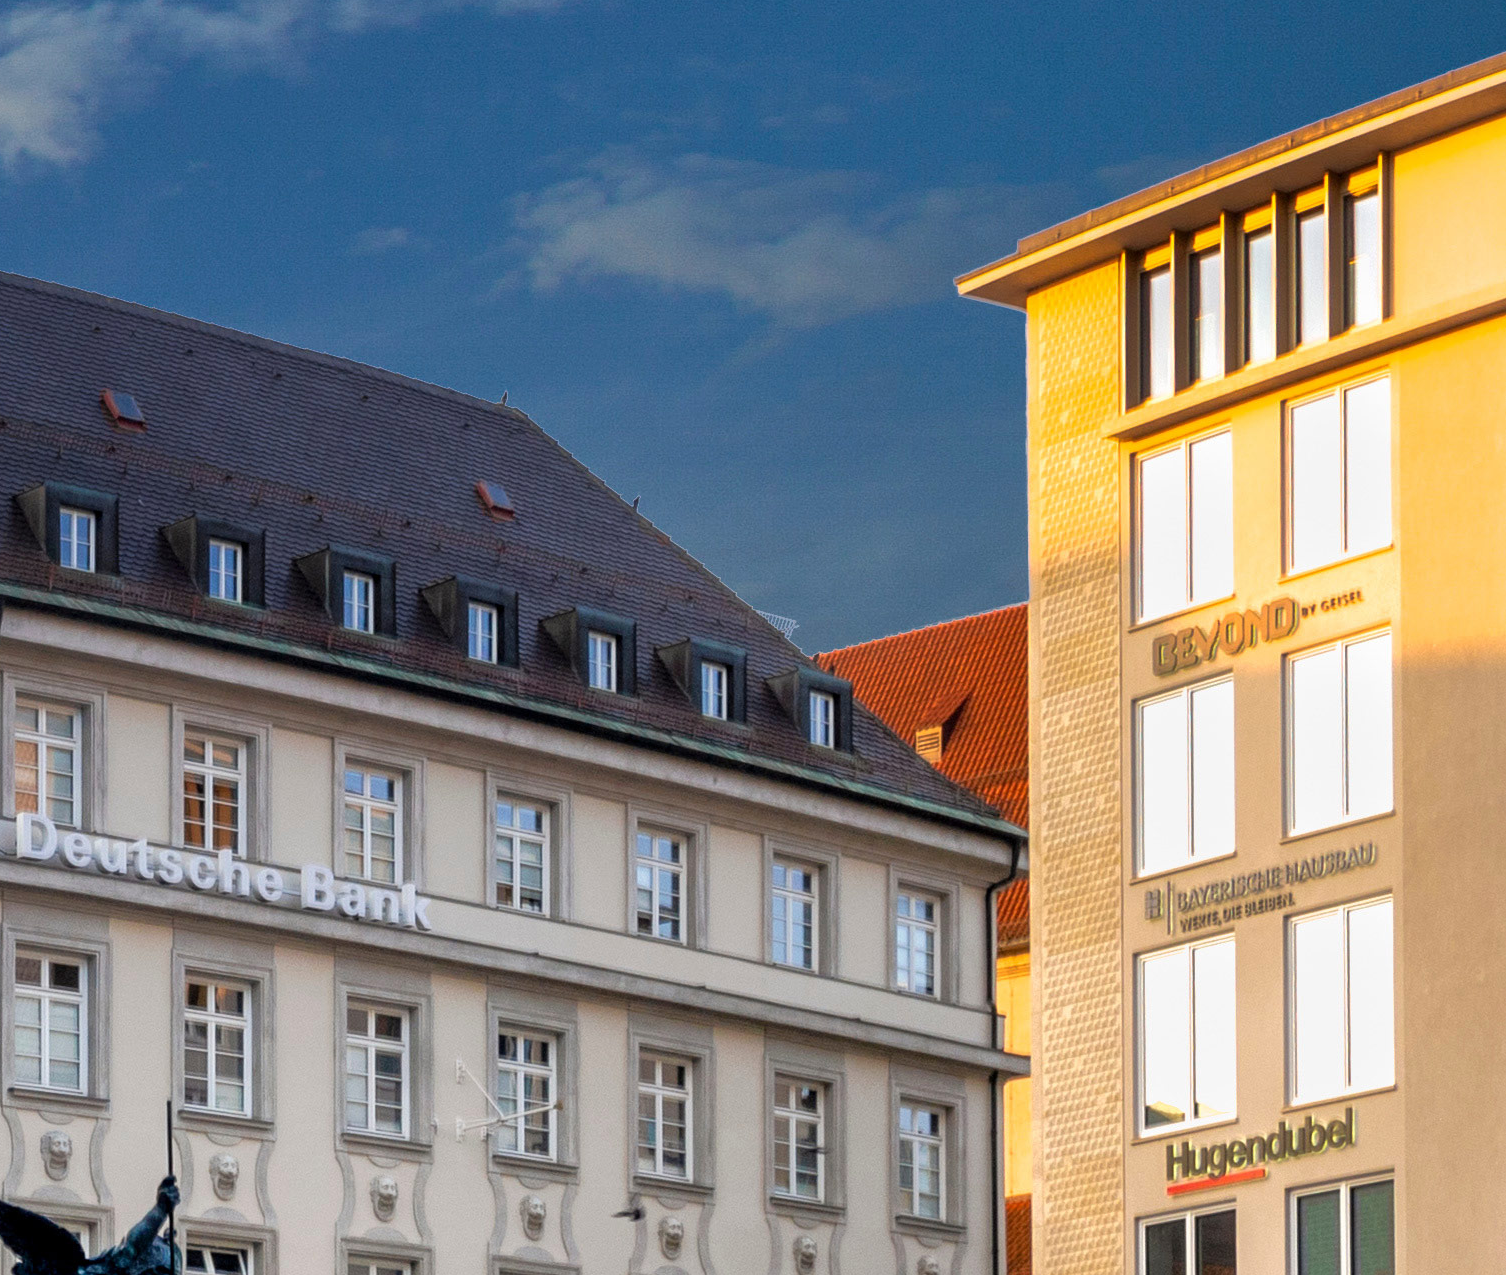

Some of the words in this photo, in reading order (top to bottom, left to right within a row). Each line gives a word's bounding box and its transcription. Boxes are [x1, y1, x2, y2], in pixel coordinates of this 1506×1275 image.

[1152, 597, 1299, 676] BEYOND
[1320, 590, 1365, 613] GEISEL
[16, 812, 282, 903] Deutsche
[301, 864, 432, 931] Bank
[1177, 866, 1281, 912] BAYERISCHE
[1285, 841, 1377, 885] HAUSBAU
[1223, 905, 1242, 922] DIE
[1166, 1107, 1354, 1181] Hugendubel
